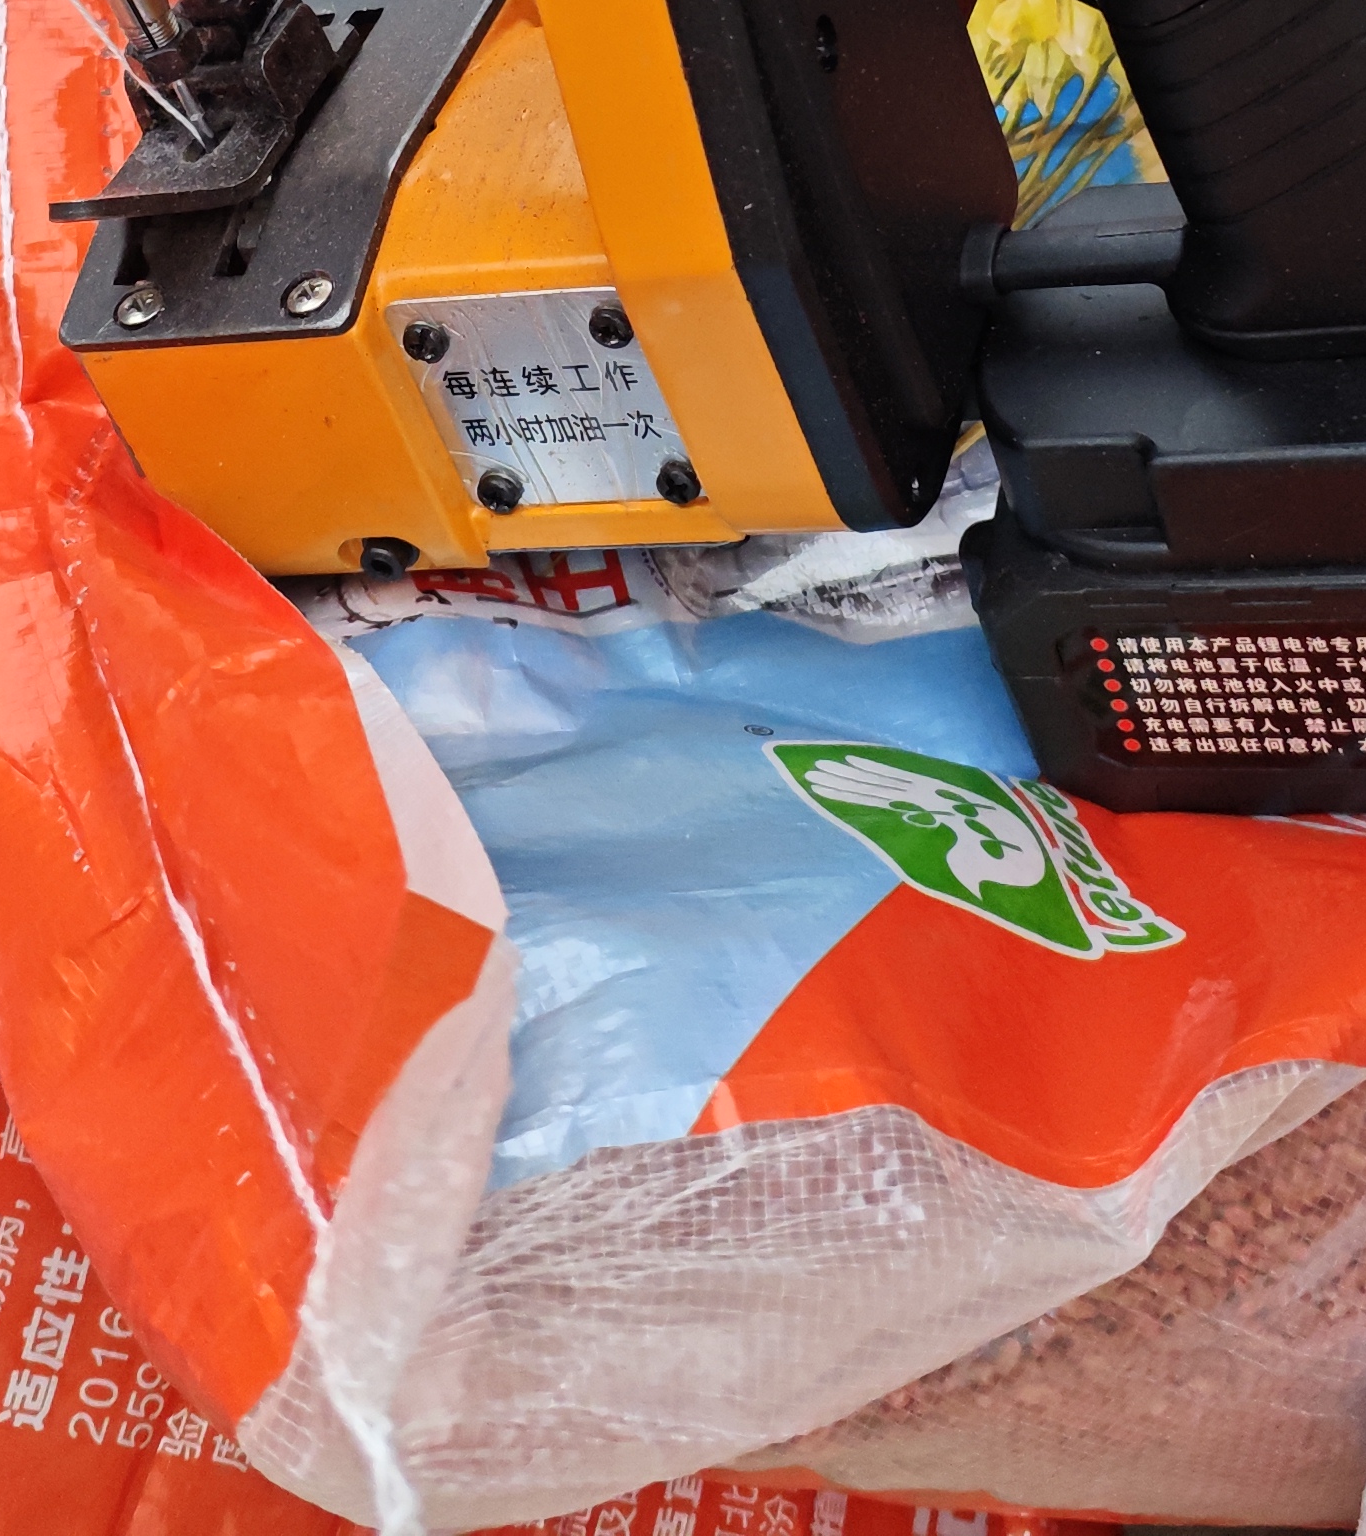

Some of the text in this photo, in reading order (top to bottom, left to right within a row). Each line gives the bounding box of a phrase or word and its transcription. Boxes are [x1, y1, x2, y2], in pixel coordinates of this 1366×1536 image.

[442, 360, 639, 400] 每连续工作
[464, 411, 662, 446] 两小时加油一次
